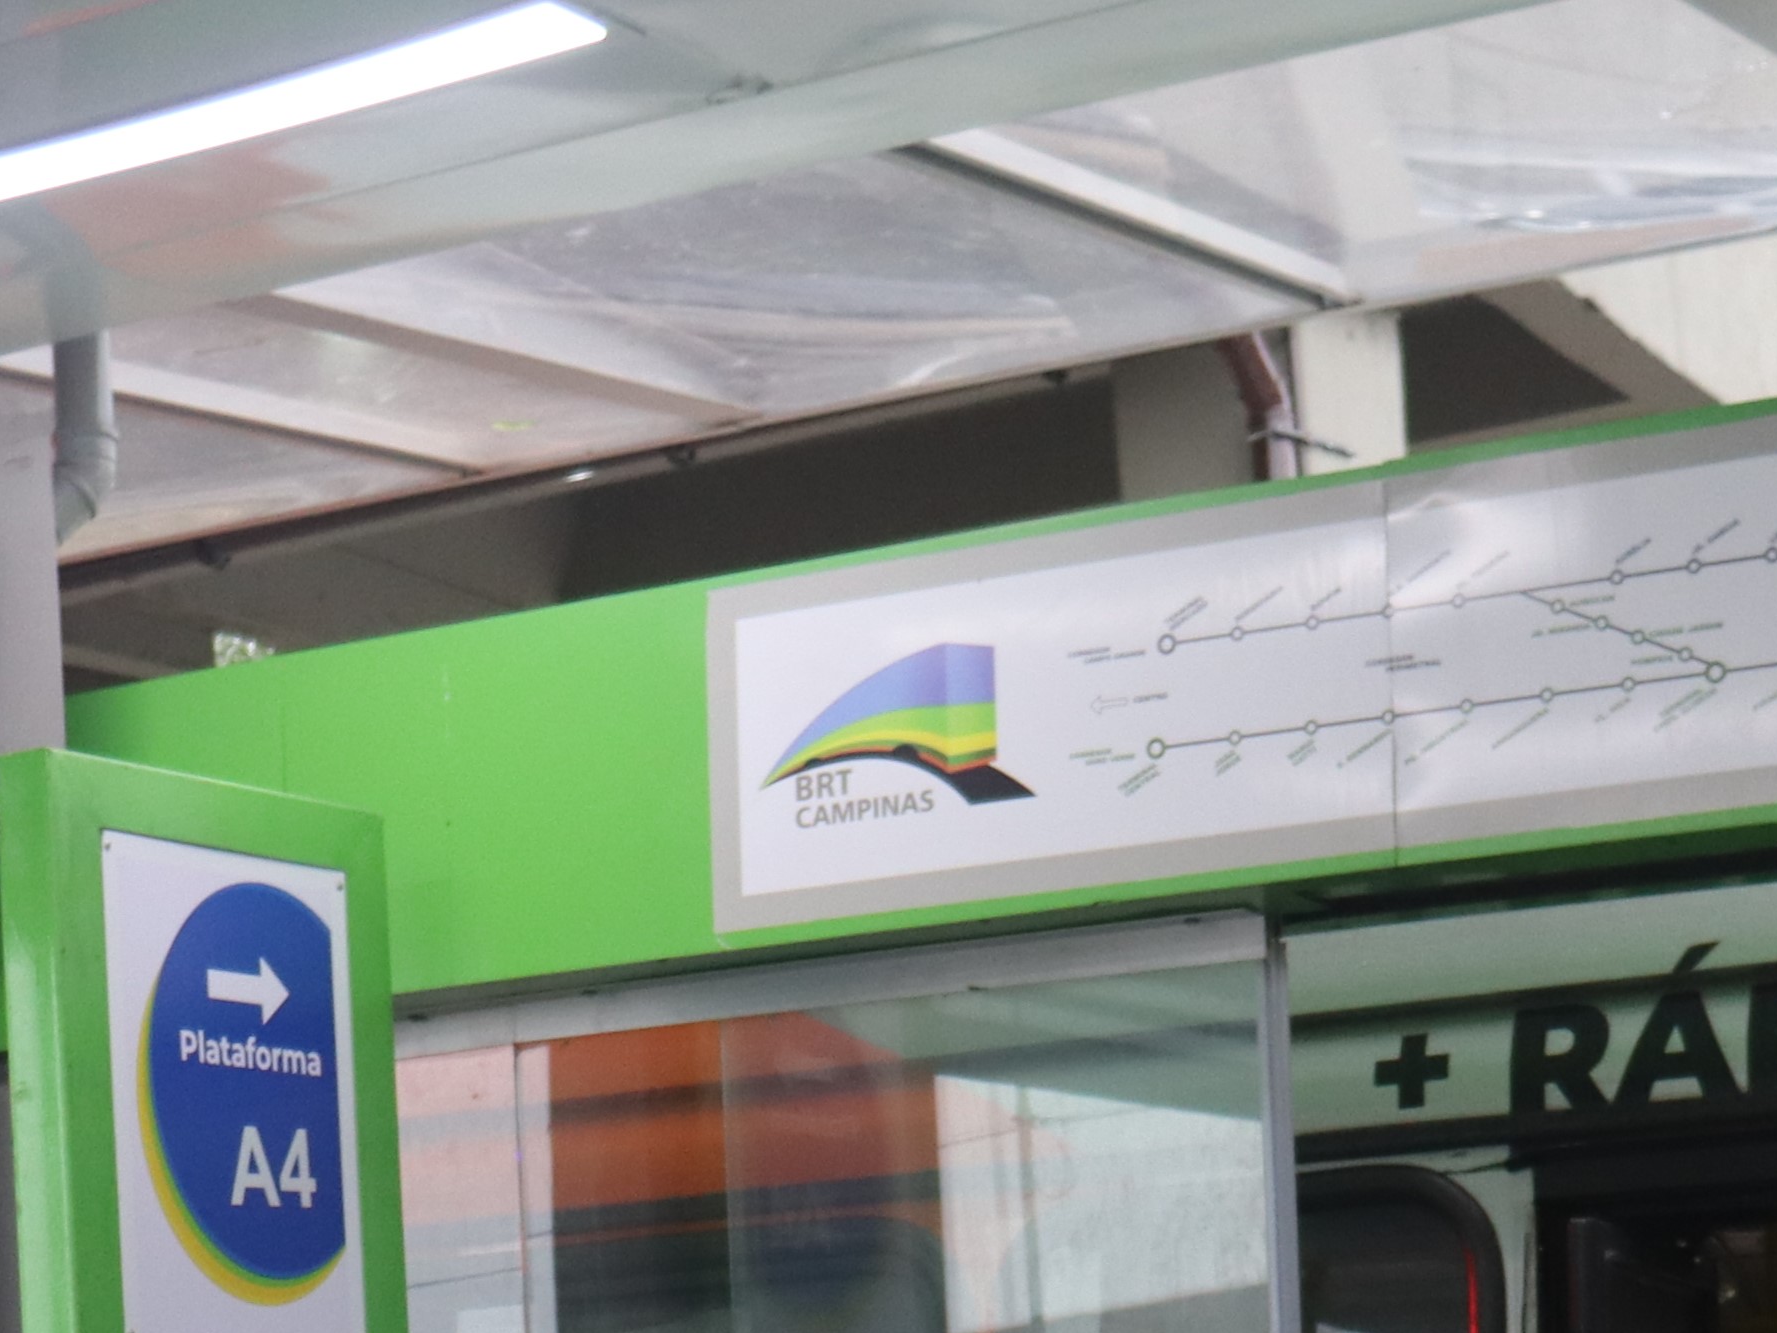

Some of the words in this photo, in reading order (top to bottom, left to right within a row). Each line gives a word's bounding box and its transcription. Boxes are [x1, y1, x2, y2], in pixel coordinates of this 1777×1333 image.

[796, 769, 852, 802] BRT
[796, 789, 934, 829] CAMPINAS
[179, 1029, 322, 1077] Plataforma
[231, 1125, 317, 1208] A4
